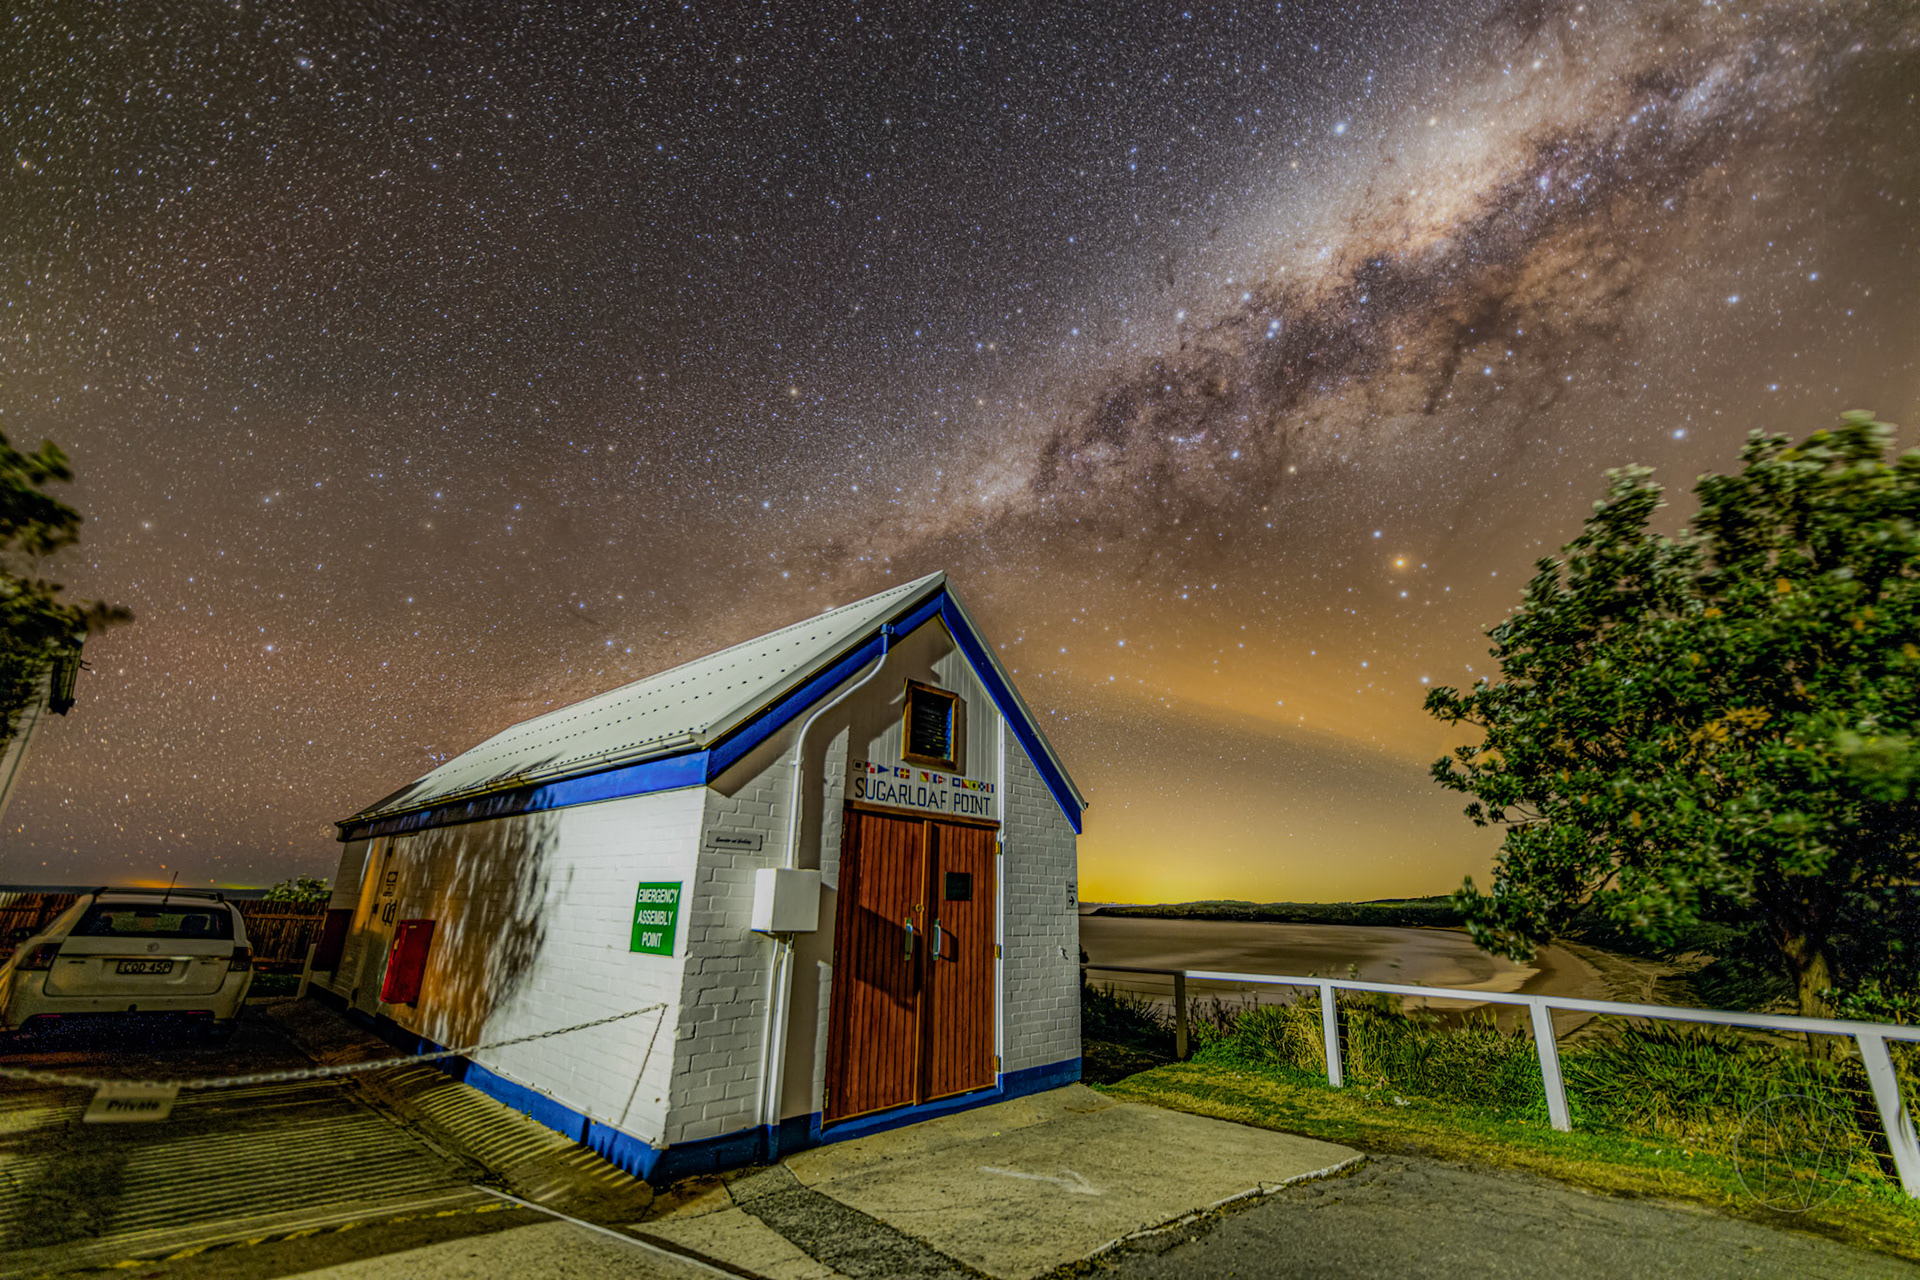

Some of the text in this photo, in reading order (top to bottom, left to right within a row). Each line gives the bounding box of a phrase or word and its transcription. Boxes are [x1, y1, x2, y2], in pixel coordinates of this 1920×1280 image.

[854, 776, 991, 816] SUGARLOAF POINT
[638, 888, 679, 903] EMERGENCY
[637, 910, 674, 925] ASSEMBLY
[641, 931, 663, 948] POINT
[105, 1097, 160, 1112] Private
